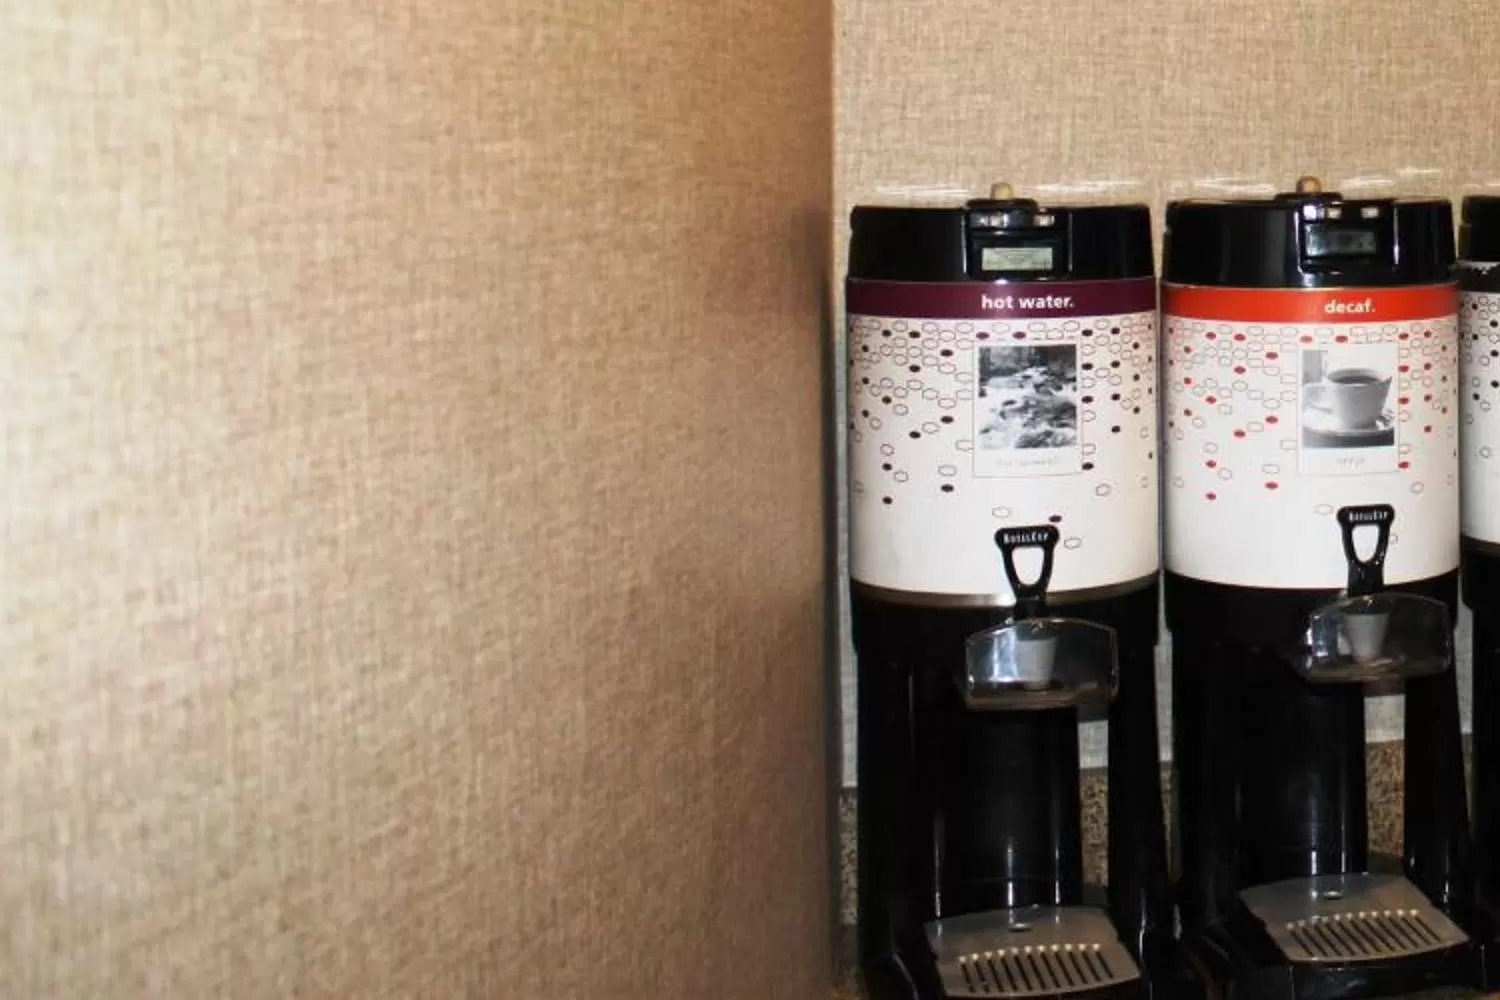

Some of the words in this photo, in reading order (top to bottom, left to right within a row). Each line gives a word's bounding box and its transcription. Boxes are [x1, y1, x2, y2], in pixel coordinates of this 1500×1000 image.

[980, 292, 1014, 310] hot
[1018, 294, 1075, 310] water.
[1324, 296, 1377, 314] decaf.
